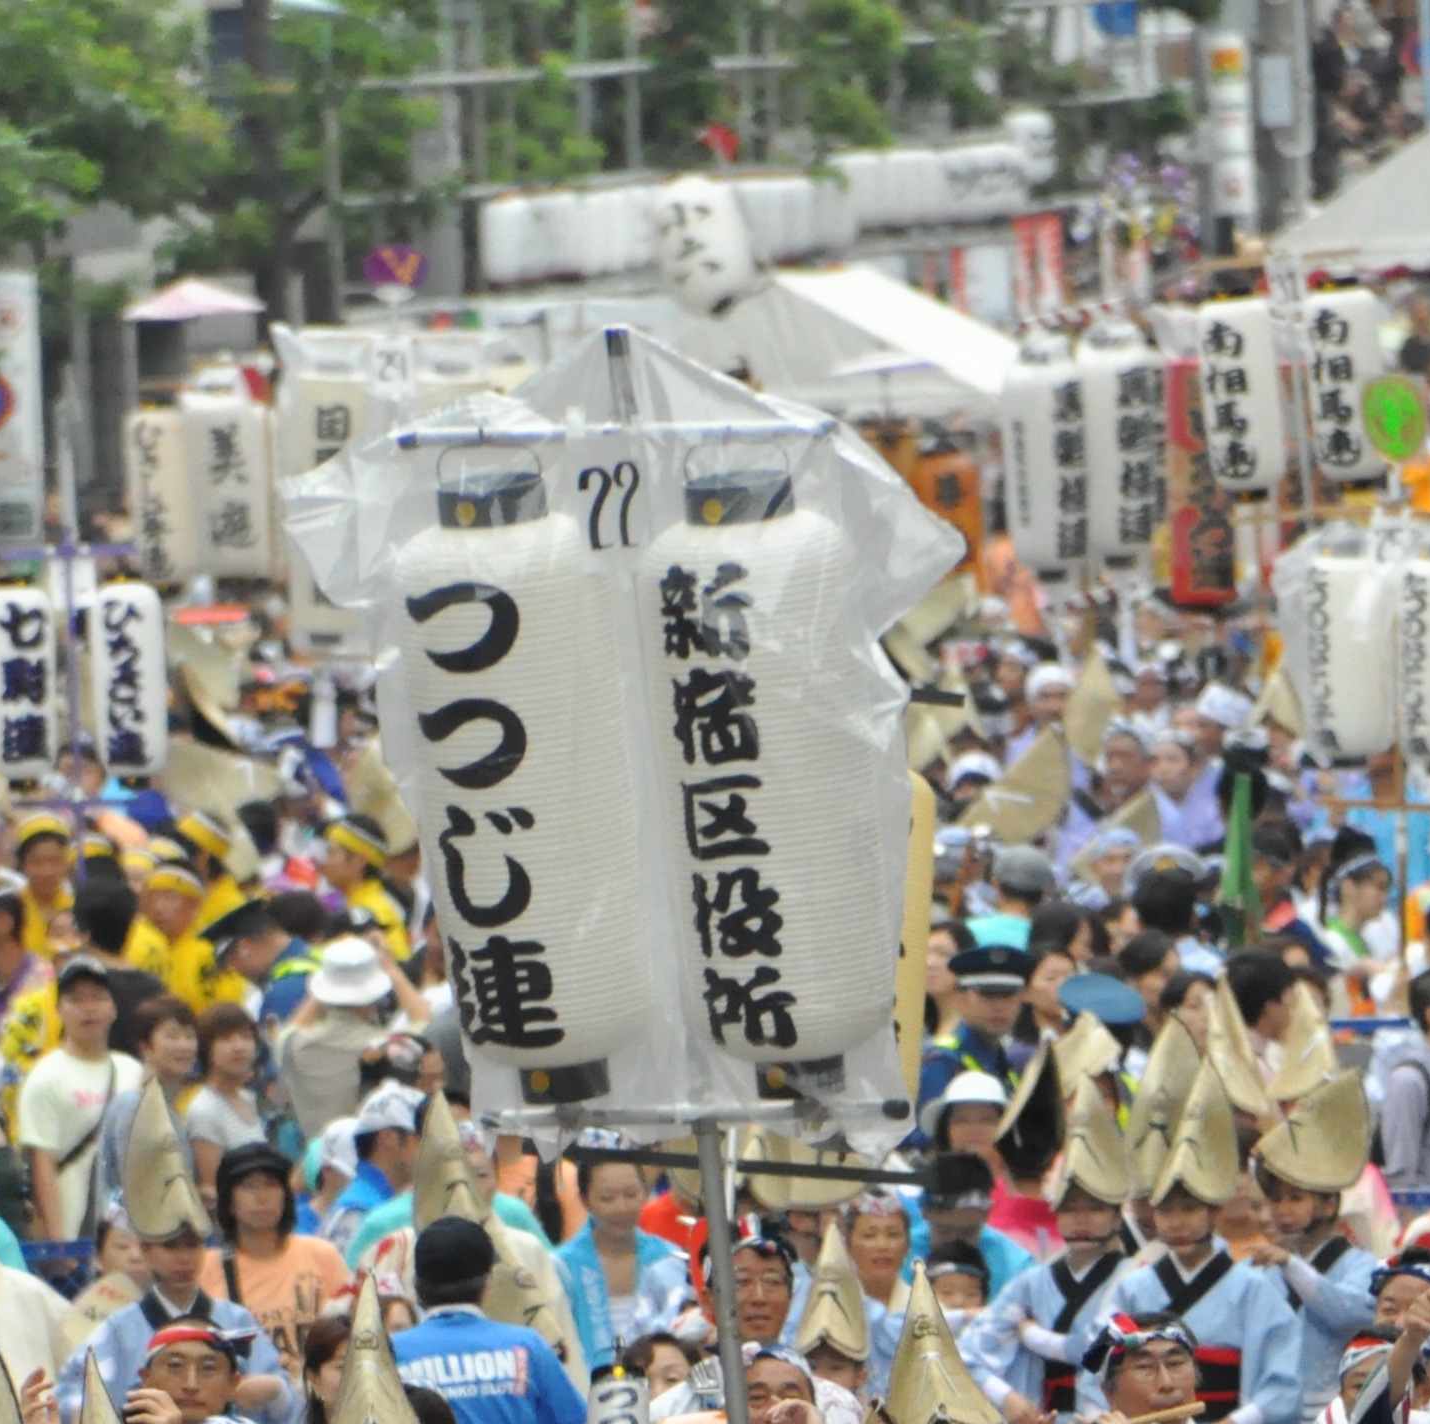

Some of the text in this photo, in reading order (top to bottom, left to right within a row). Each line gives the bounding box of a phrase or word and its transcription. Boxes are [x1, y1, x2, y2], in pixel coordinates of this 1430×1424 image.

[577, 461, 641, 550] 22
[405, 580, 565, 1049] つつじ連
[659, 561, 798, 1050] 新宿区役所
